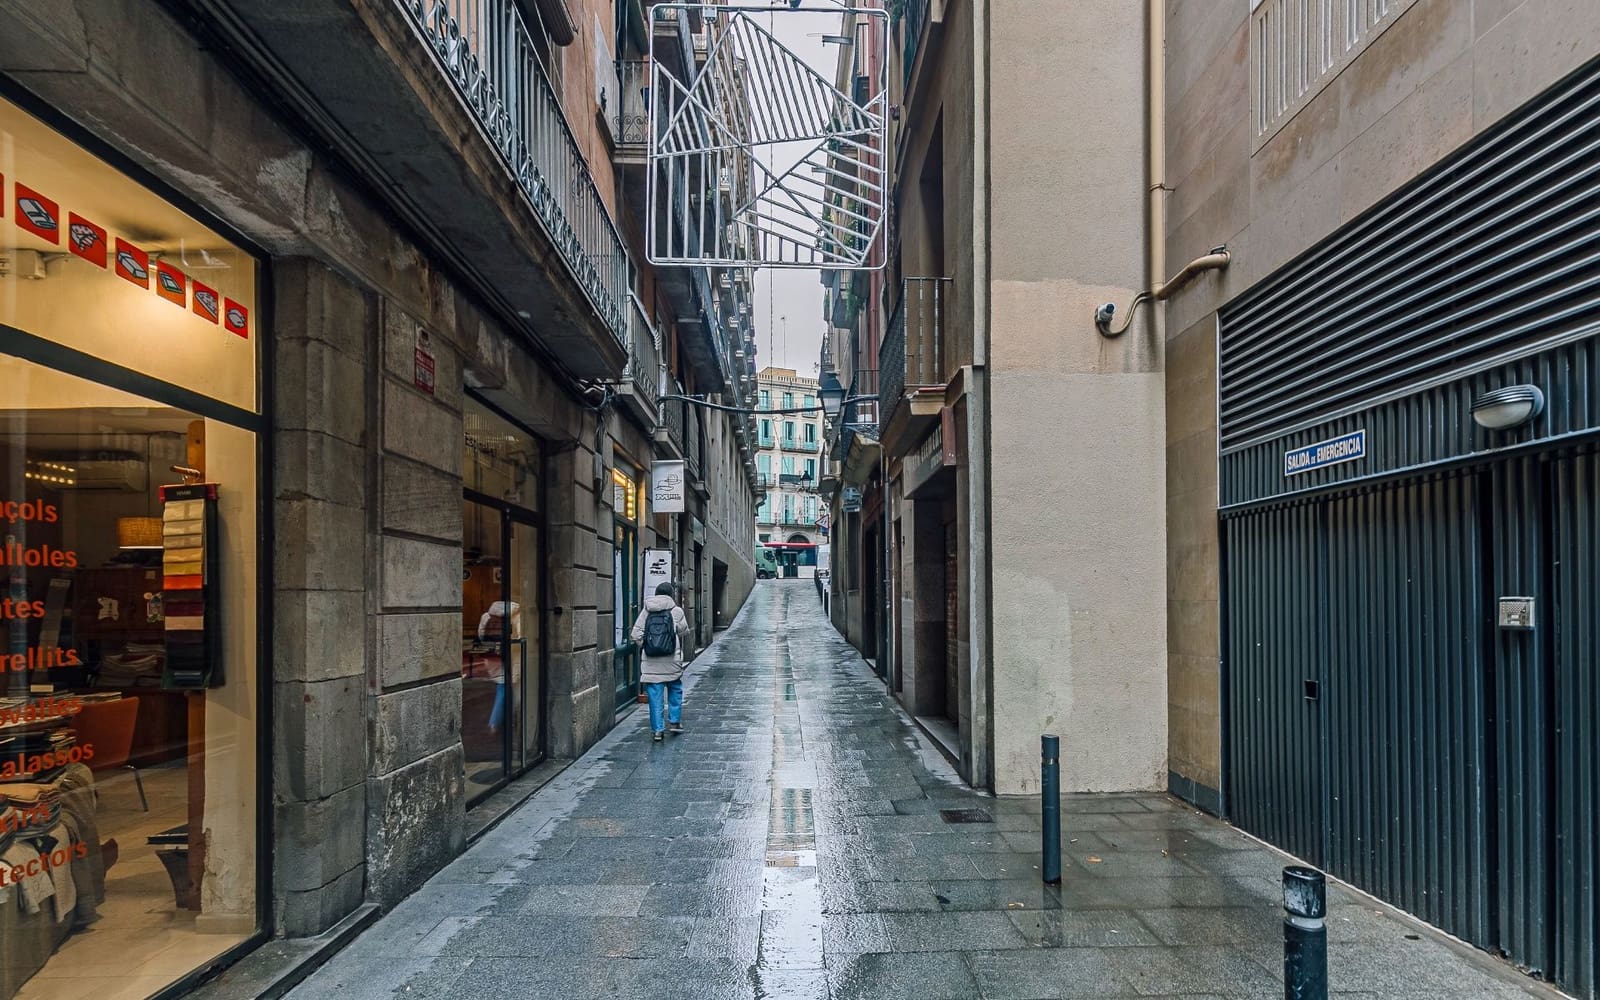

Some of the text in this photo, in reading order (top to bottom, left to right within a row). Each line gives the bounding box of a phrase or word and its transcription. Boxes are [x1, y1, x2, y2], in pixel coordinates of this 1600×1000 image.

[1287, 451, 1311, 470] SALIDA
[1317, 437, 1361, 462] EMERGENCIA
[0, 498, 58, 524] çols
[0, 597, 46, 620] tes
[2, 743, 94, 780] alassos
